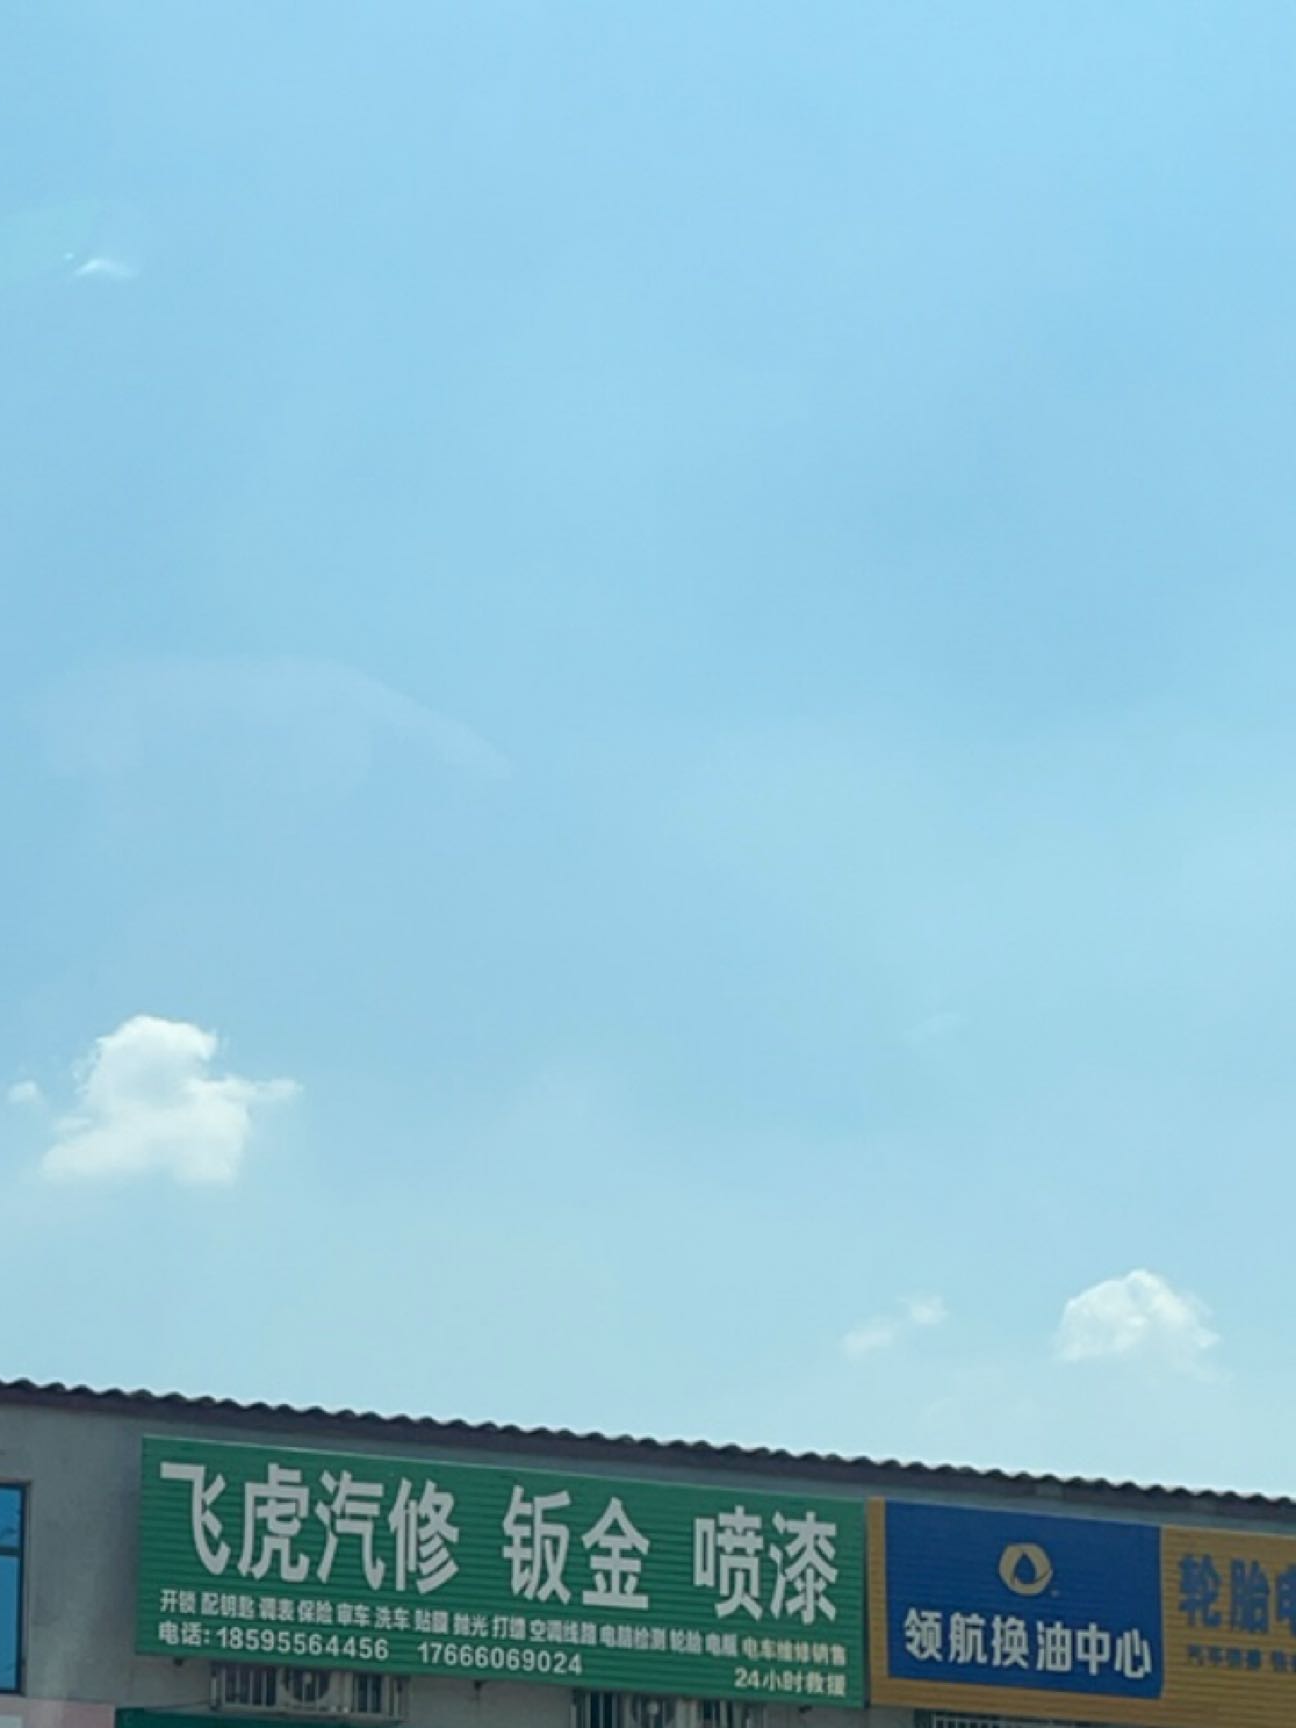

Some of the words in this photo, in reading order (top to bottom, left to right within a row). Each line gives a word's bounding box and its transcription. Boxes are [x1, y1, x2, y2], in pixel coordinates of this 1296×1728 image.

[160, 1461, 459, 1594] 飞虎汽修
[503, 1485, 649, 1609] 钣金
[692, 1505, 838, 1624] 喷漆
[417, 1641, 583, 1675] 17666069024
[904, 1607, 1152, 1679] 领航换油中心
